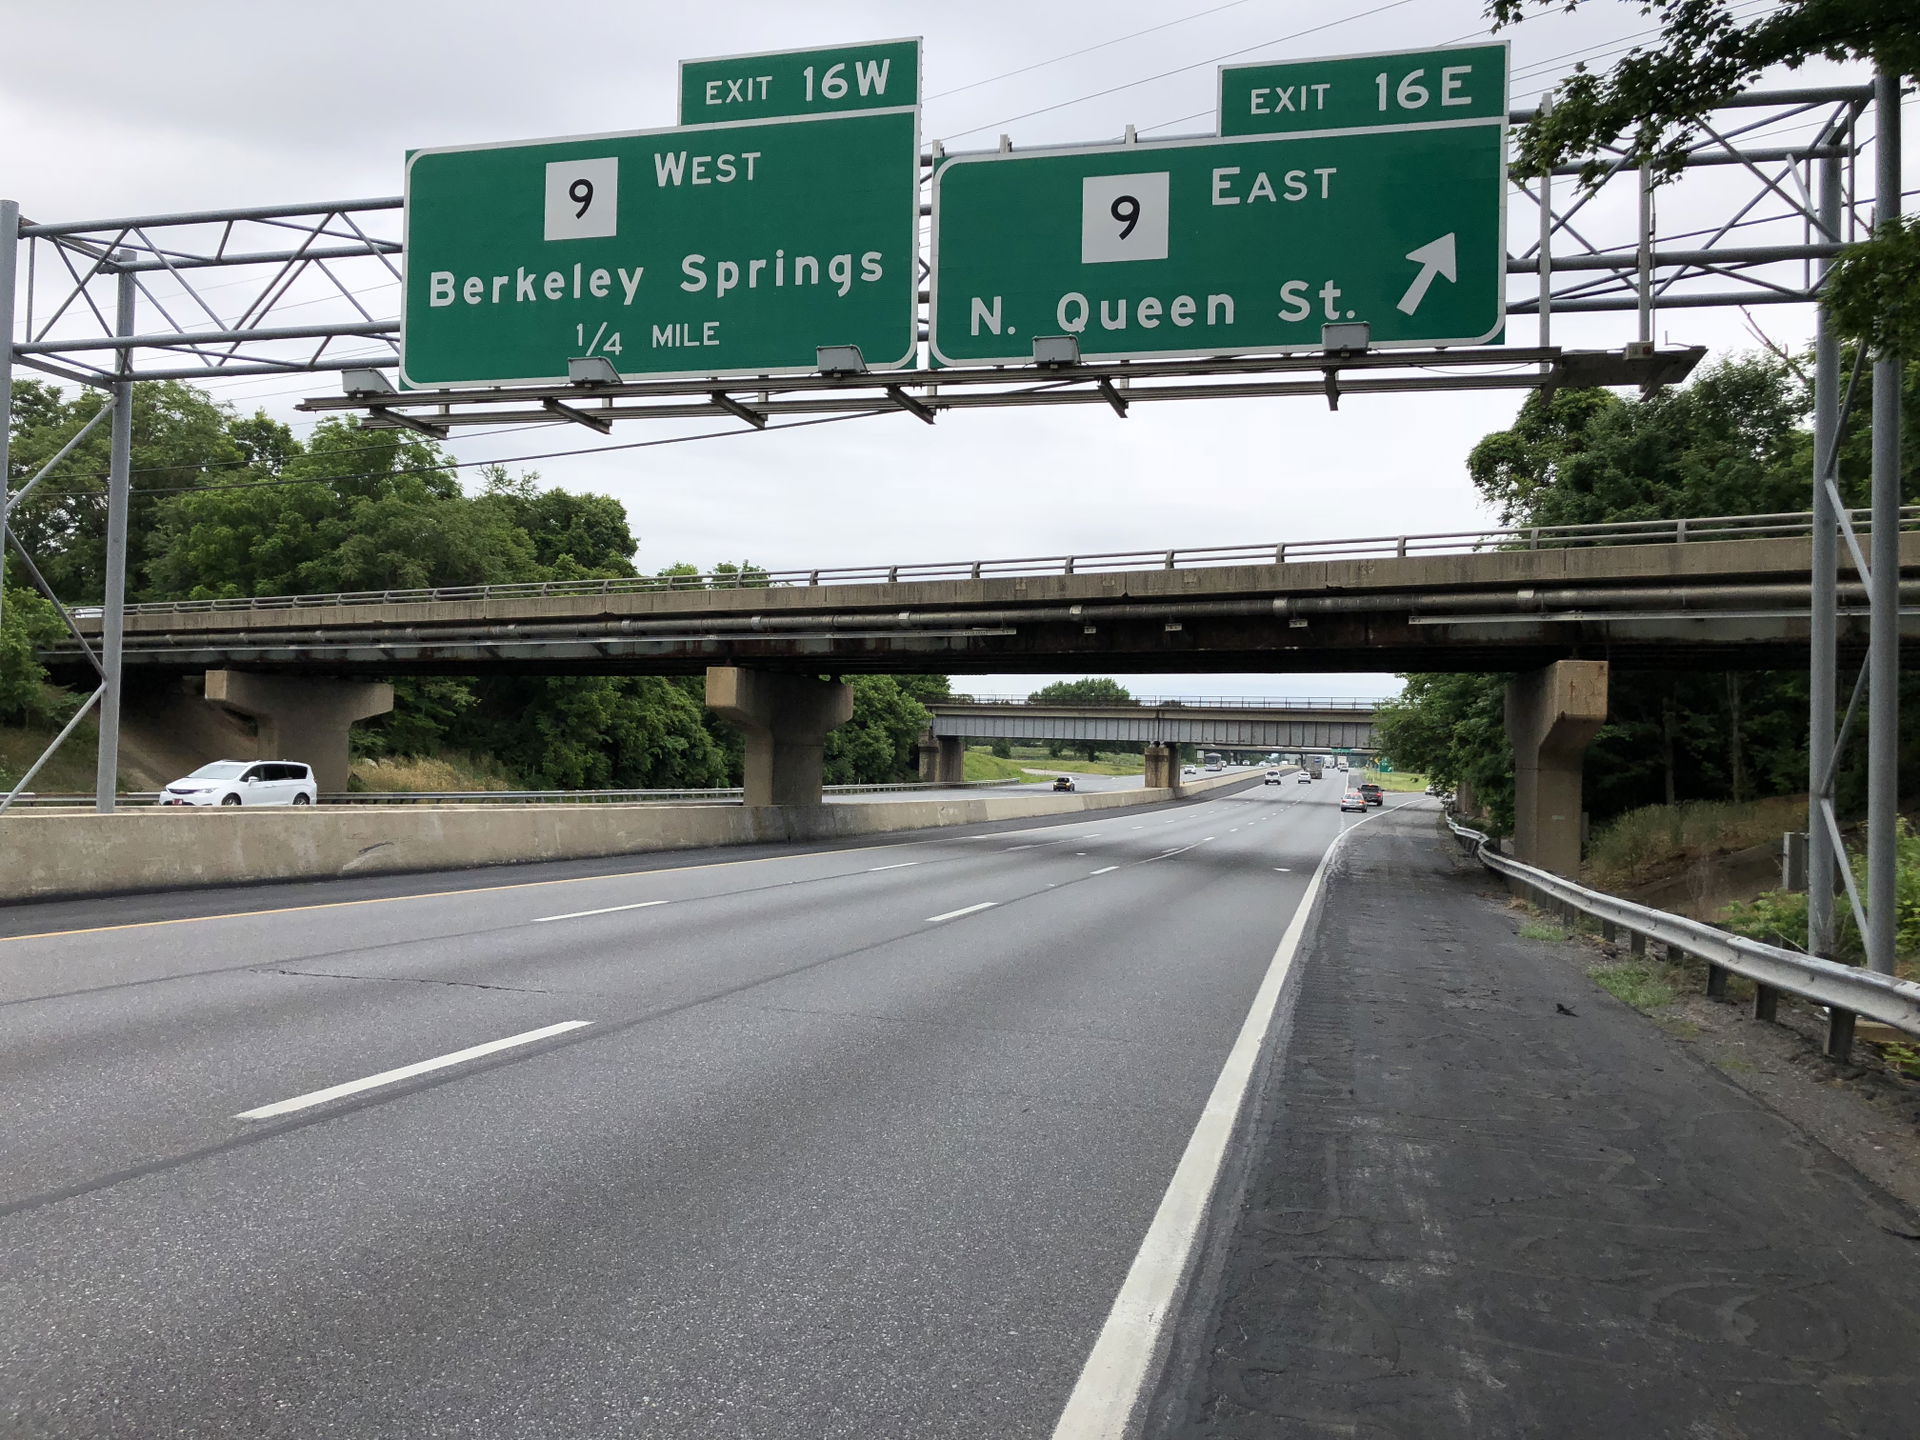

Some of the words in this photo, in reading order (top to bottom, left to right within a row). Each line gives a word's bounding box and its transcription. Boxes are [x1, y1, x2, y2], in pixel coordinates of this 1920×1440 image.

[706, 77, 772, 104] EXIT
[804, 59, 890, 101] 16W
[1251, 85, 1330, 114] EXIT
[1376, 66, 1471, 110] 16E
[654, 151, 760, 187] WEST
[1212, 167, 1336, 205] EAST
[569, 179, 593, 219] 9
[1111, 195, 1140, 240] 9
[430, 263, 643, 307] Berkeley
[681, 250, 882, 298] Springs
[971, 296, 1015, 335] N.
[1057, 292, 1234, 332] Queen
[1279, 280, 1356, 321] St.
[577, 322, 622, 356] 1/4
[653, 322, 719, 347] MILE
